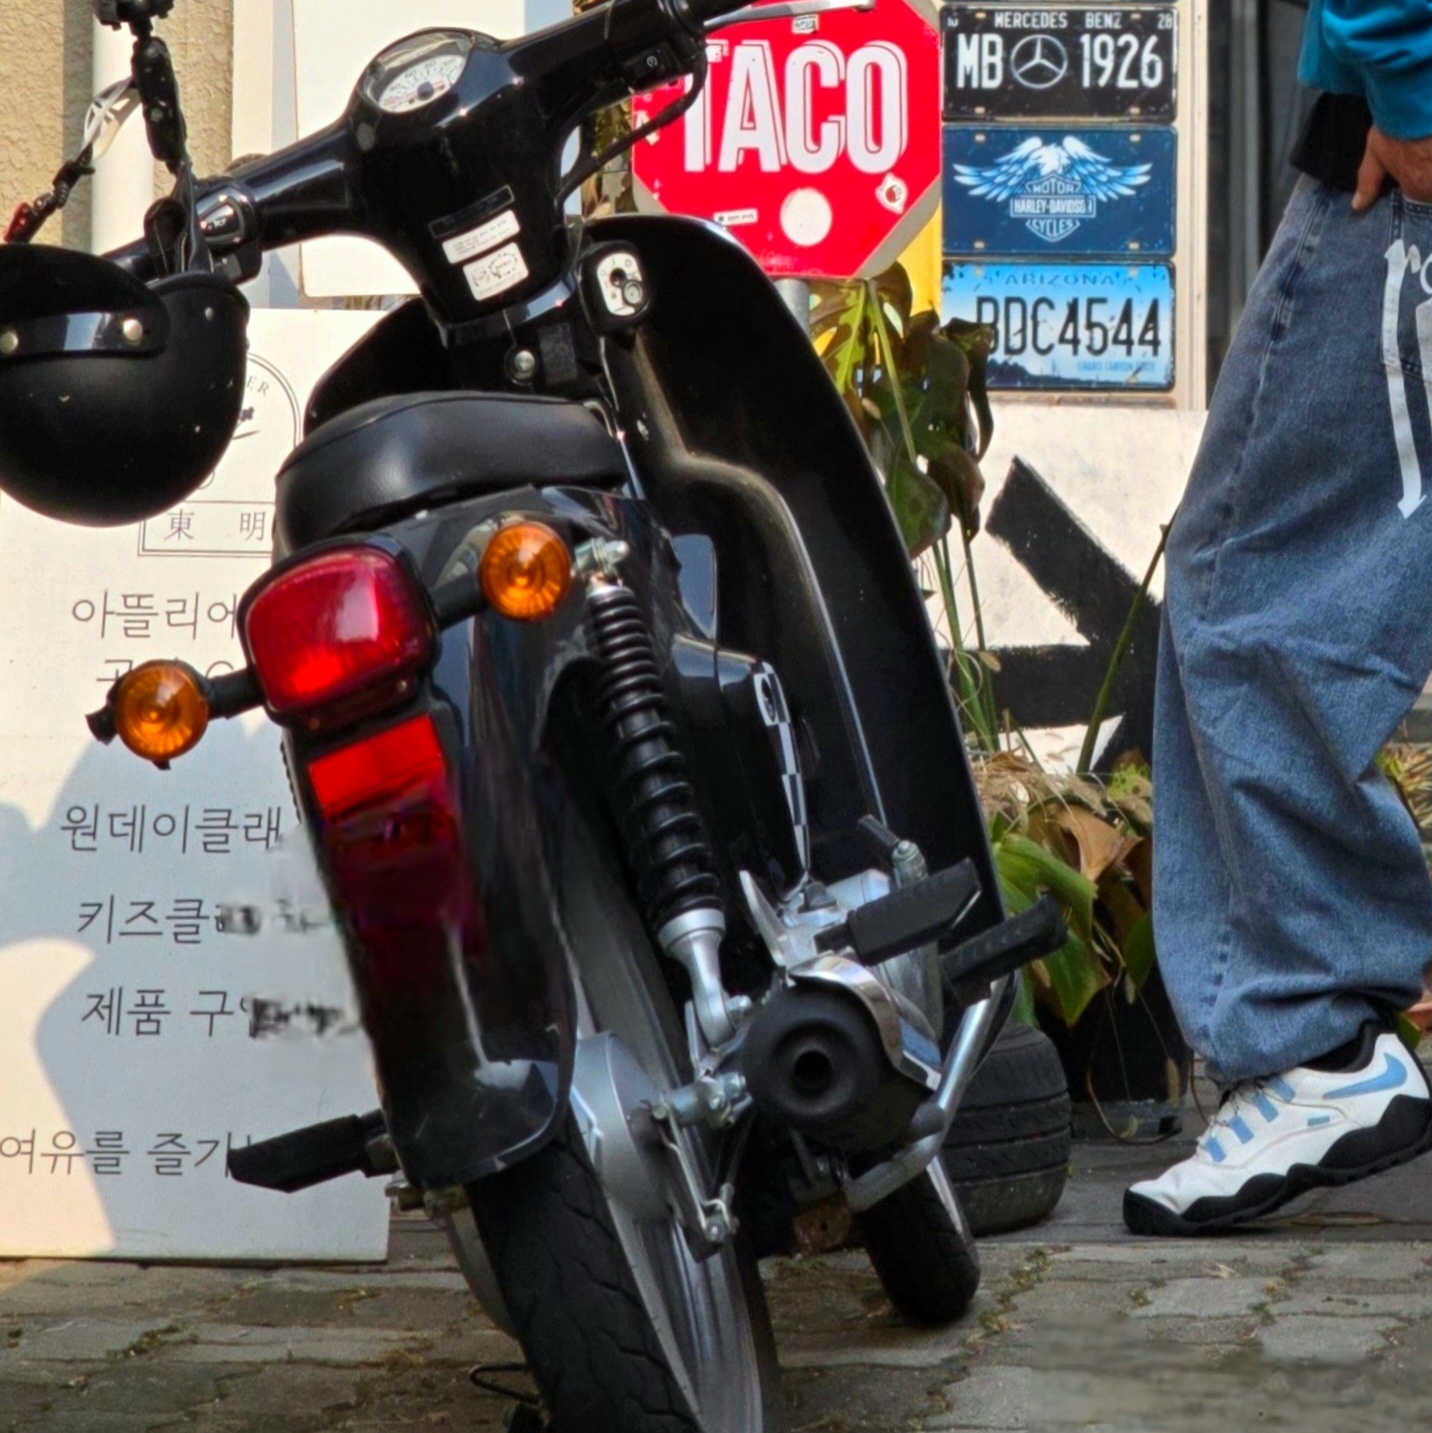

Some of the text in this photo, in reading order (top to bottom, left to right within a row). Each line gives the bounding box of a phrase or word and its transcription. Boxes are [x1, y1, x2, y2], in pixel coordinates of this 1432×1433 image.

[993, 12, 1069, 29] MERCEDES
[1084, 12, 1122, 28] BENZ
[956, 33, 1164, 90] MB 1926
[1032, 177, 1075, 194] MOTOR
[1031, 219, 1074, 237] CYCLES
[1004, 273, 1115, 287] ARIZONA
[976, 296, 1162, 358] BDC4544
[81, 986, 172, 1038] 제품
